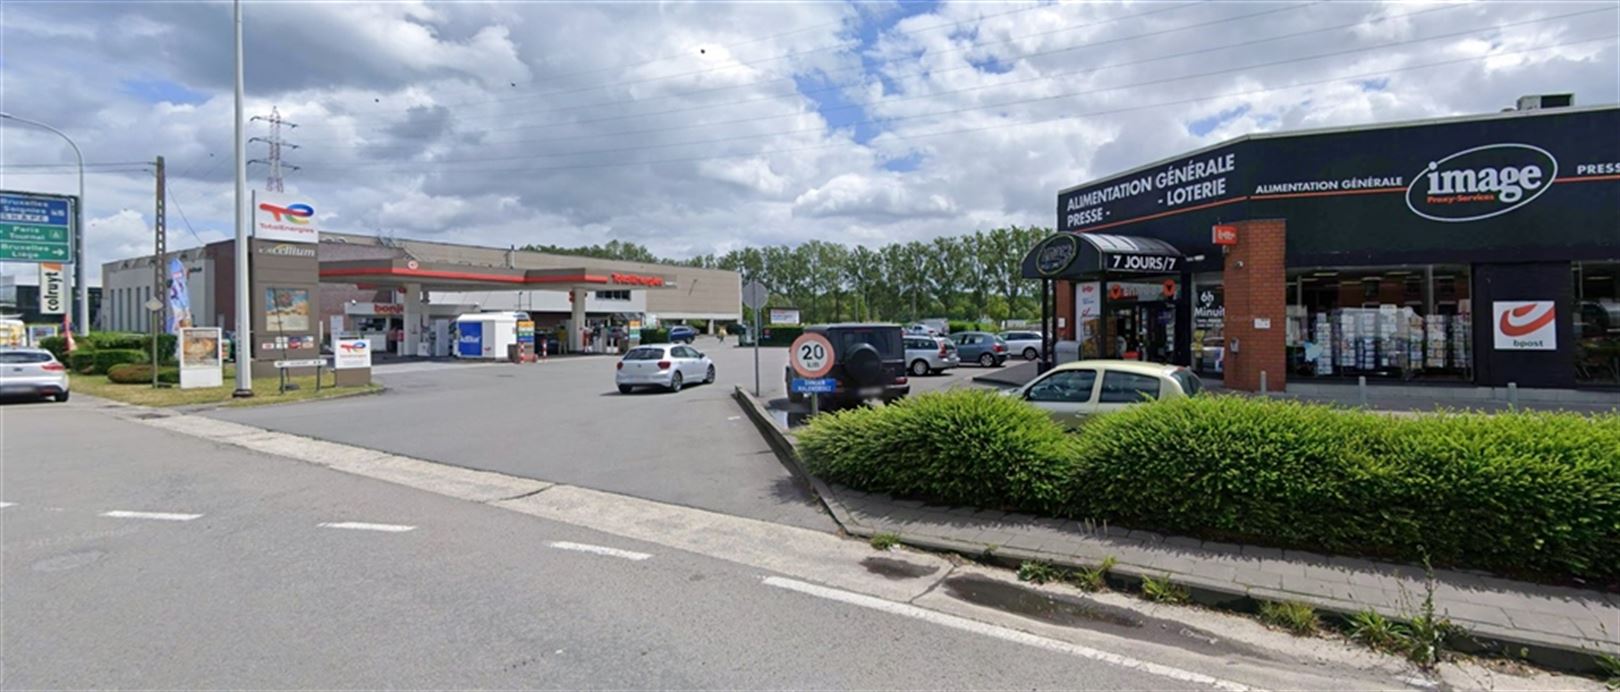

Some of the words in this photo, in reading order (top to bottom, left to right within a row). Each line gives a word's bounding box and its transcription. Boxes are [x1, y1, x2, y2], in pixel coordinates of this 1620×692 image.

[1067, 176, 1152, 212] ALIMENTATION
[1155, 153, 1235, 189] GÉNÉRALE
[1255, 180, 1339, 194] ALIMENTATION
[1342, 176, 1403, 190] GÉNÉRALE
[1427, 161, 1542, 203] image
[1067, 207, 1103, 227] PRESSE
[1167, 178, 1226, 206] LOTERIE
[1113, 254, 1122, 268] 7
[1124, 256, 1176, 271] JOURS/7
[44, 272, 63, 311] colruyt
[1200, 291, 1215, 302] 6h
[802, 345, 824, 360] 20
[1513, 339, 1544, 348] bpost
